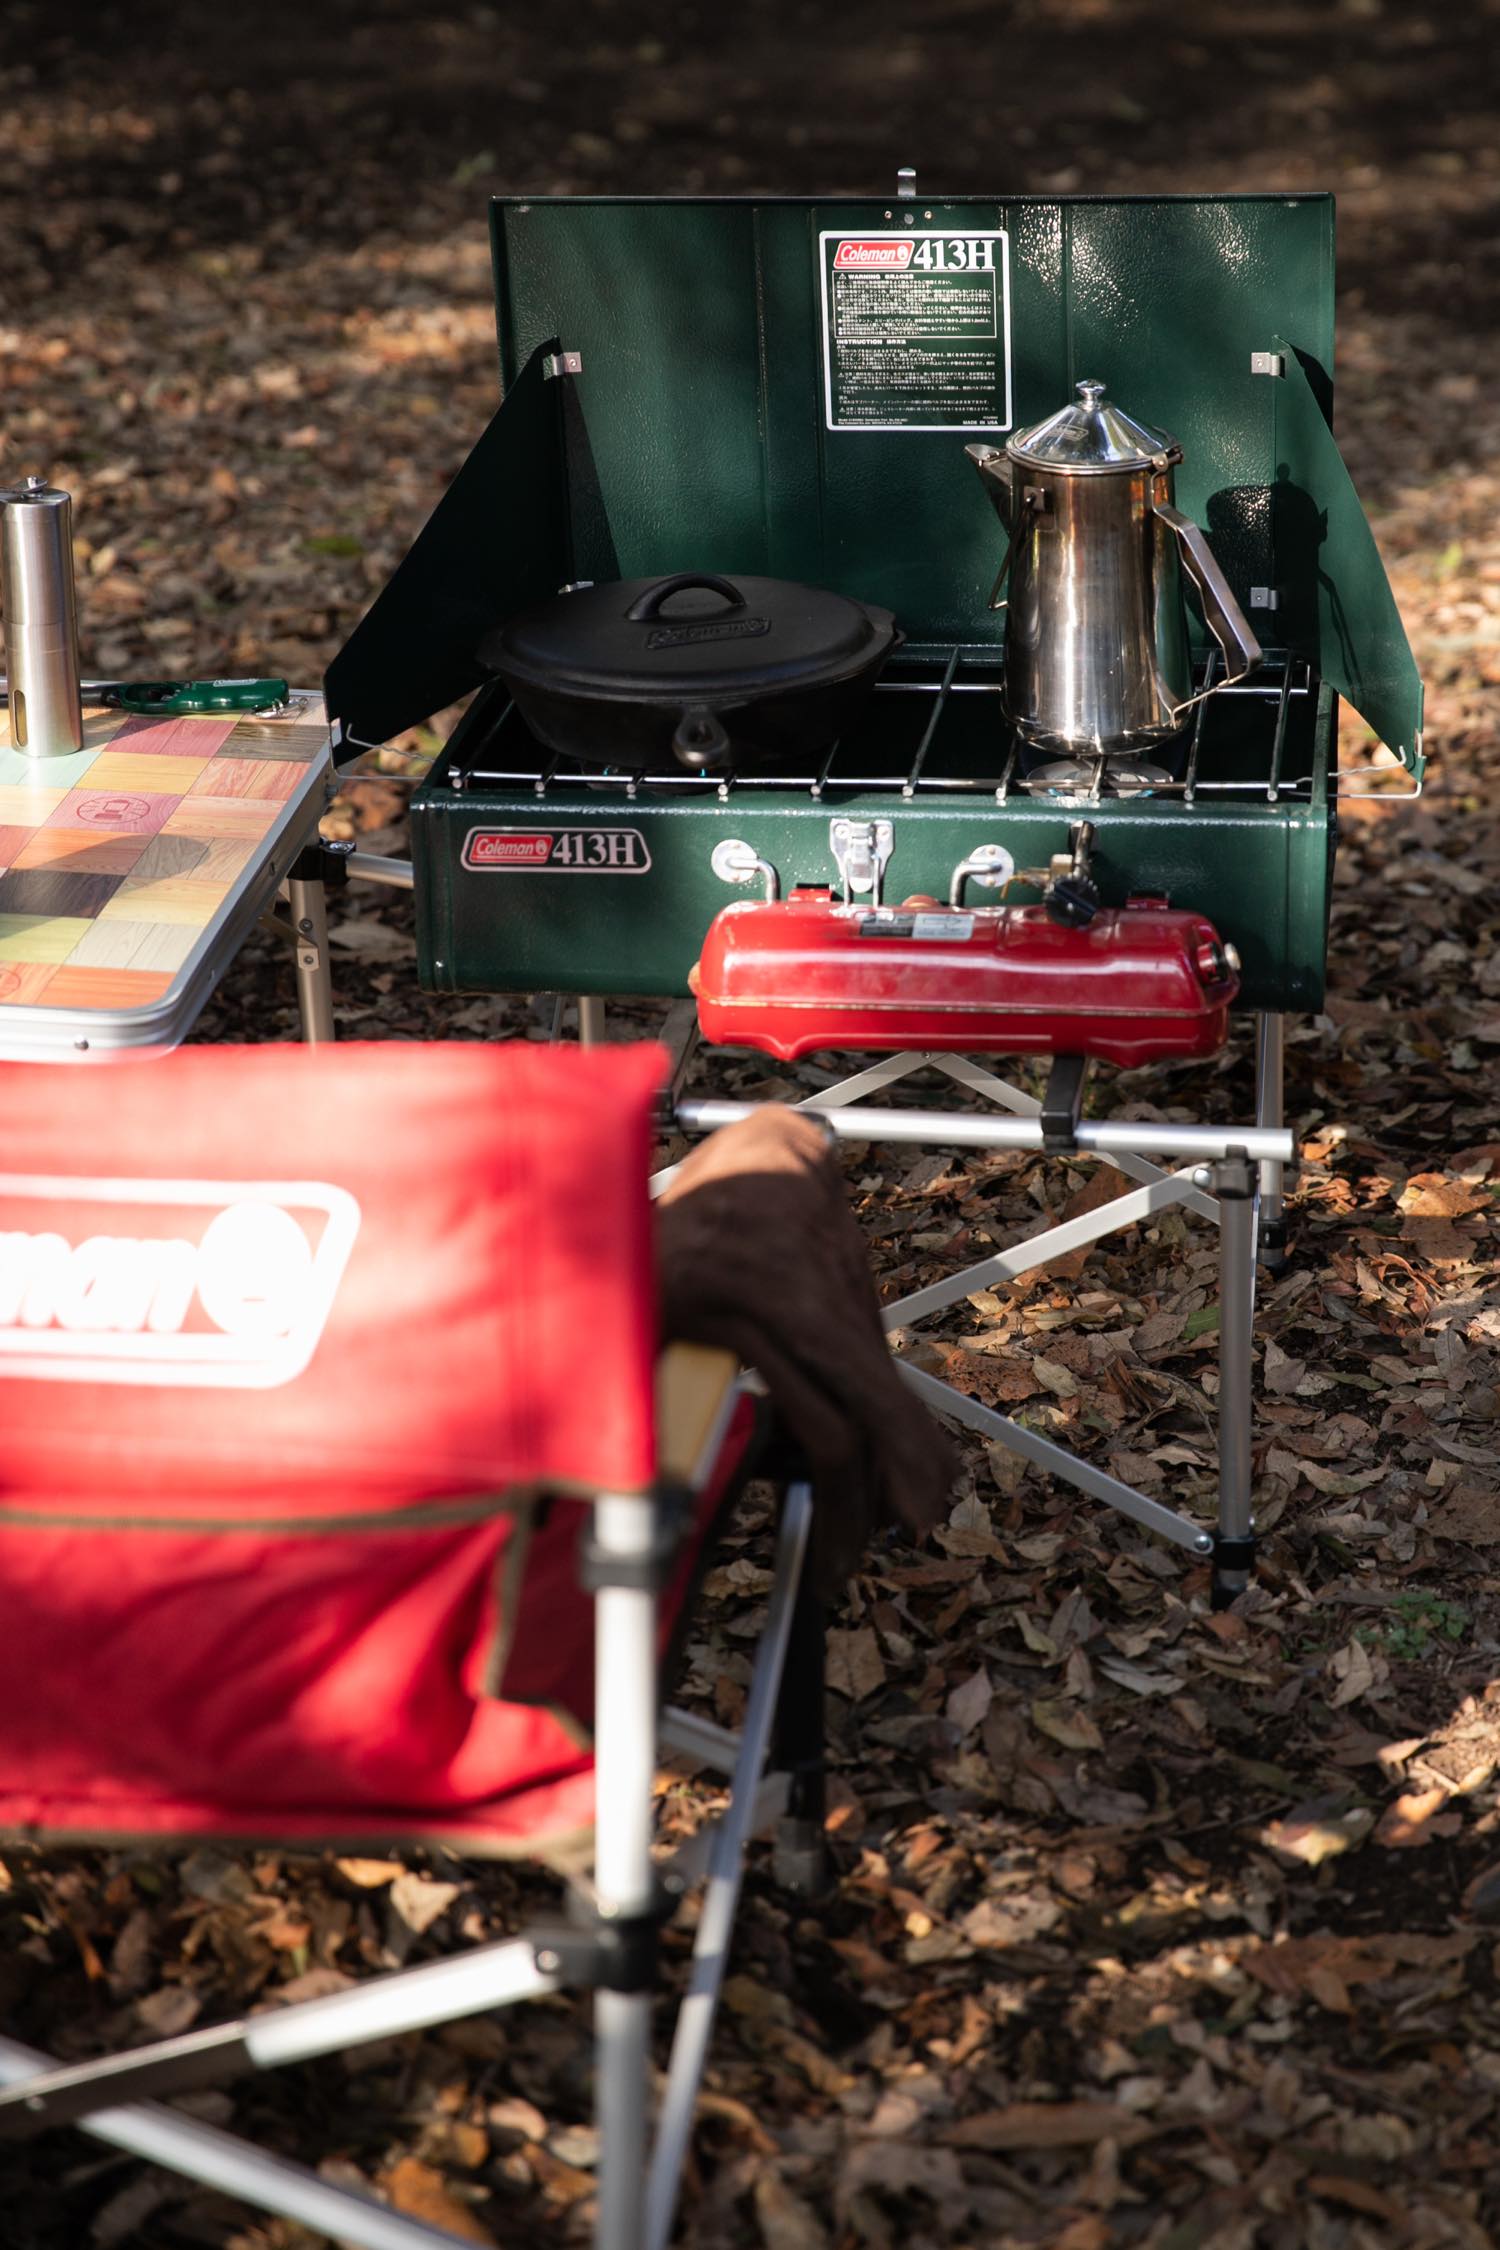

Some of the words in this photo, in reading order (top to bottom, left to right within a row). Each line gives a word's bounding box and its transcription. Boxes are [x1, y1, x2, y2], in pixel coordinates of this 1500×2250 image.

[840, 244, 897, 261] Coleman
[913, 239, 996, 270] 413H
[476, 837, 534, 856] Coleman
[551, 833, 638, 865] 413H
